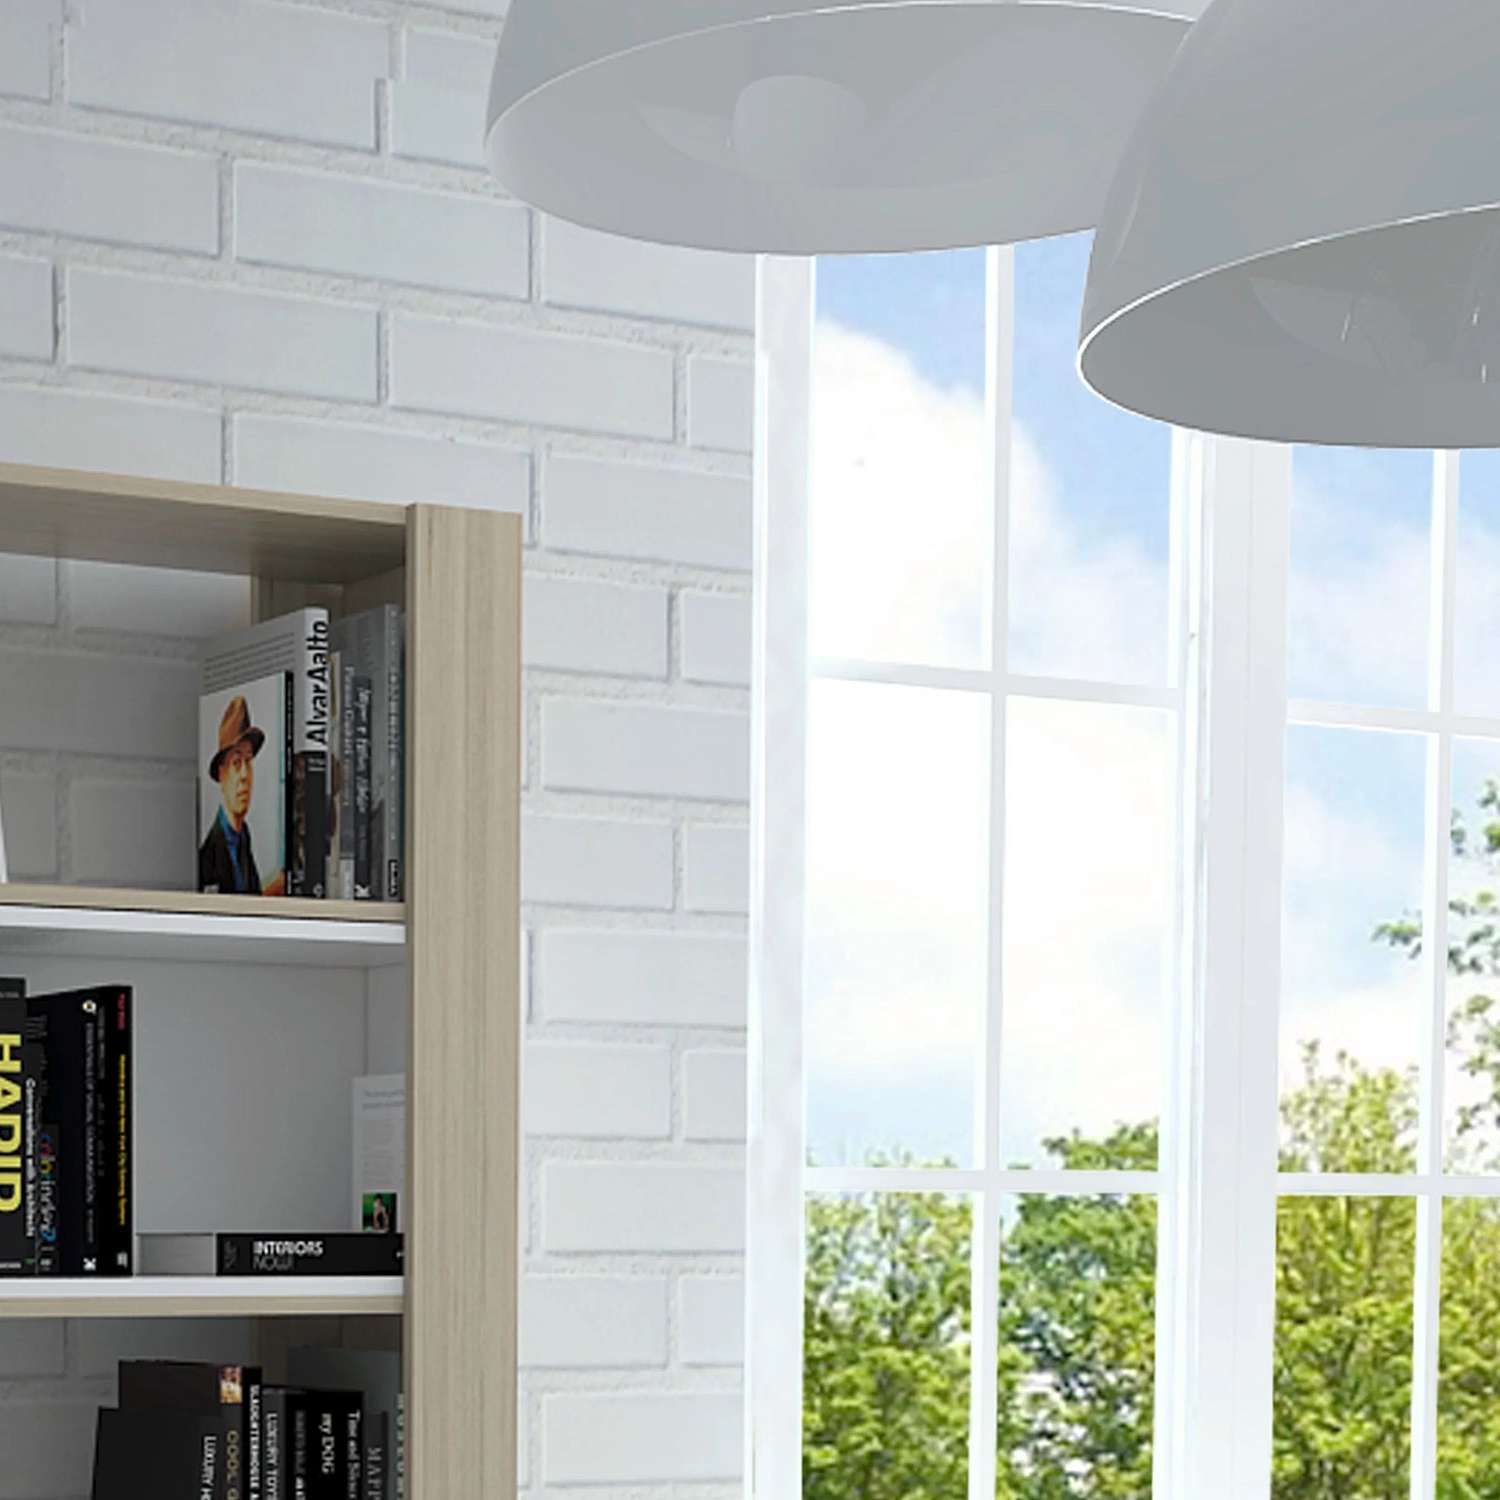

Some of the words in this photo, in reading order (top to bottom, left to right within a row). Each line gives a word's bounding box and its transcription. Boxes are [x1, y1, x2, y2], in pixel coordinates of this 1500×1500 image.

[252, 1240, 323, 1257] INTERIORS
[200, 1436, 217, 1486] LUXURY
[322, 1436, 334, 1474] DOG
